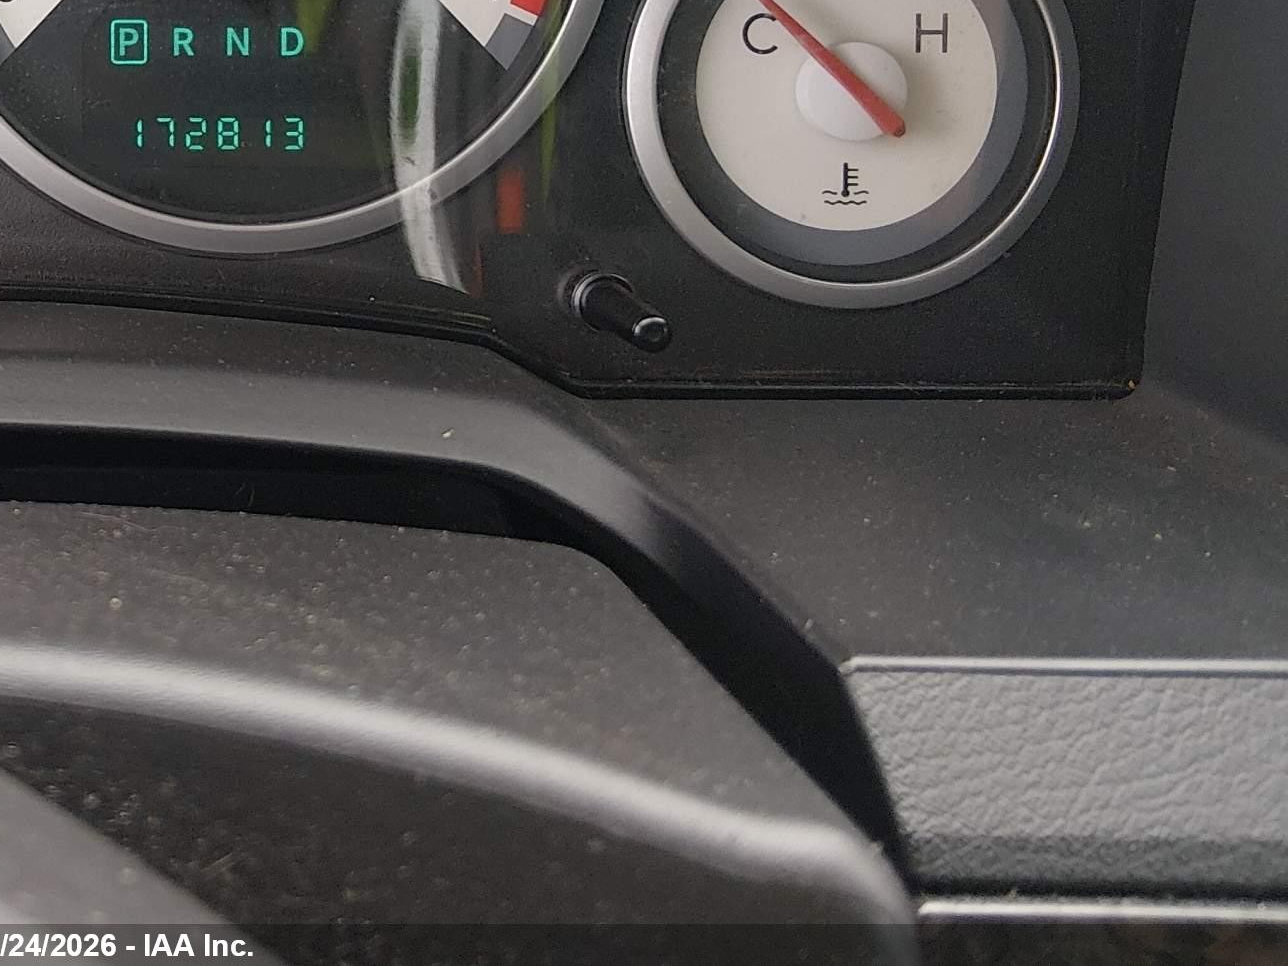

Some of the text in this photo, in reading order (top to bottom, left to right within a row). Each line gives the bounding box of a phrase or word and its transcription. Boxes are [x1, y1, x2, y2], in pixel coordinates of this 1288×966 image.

[120, 28, 303, 55] P R N D
[743, 13, 778, 54] C
[915, 13, 948, 53] H
[136, 117, 304, 151] 172813
